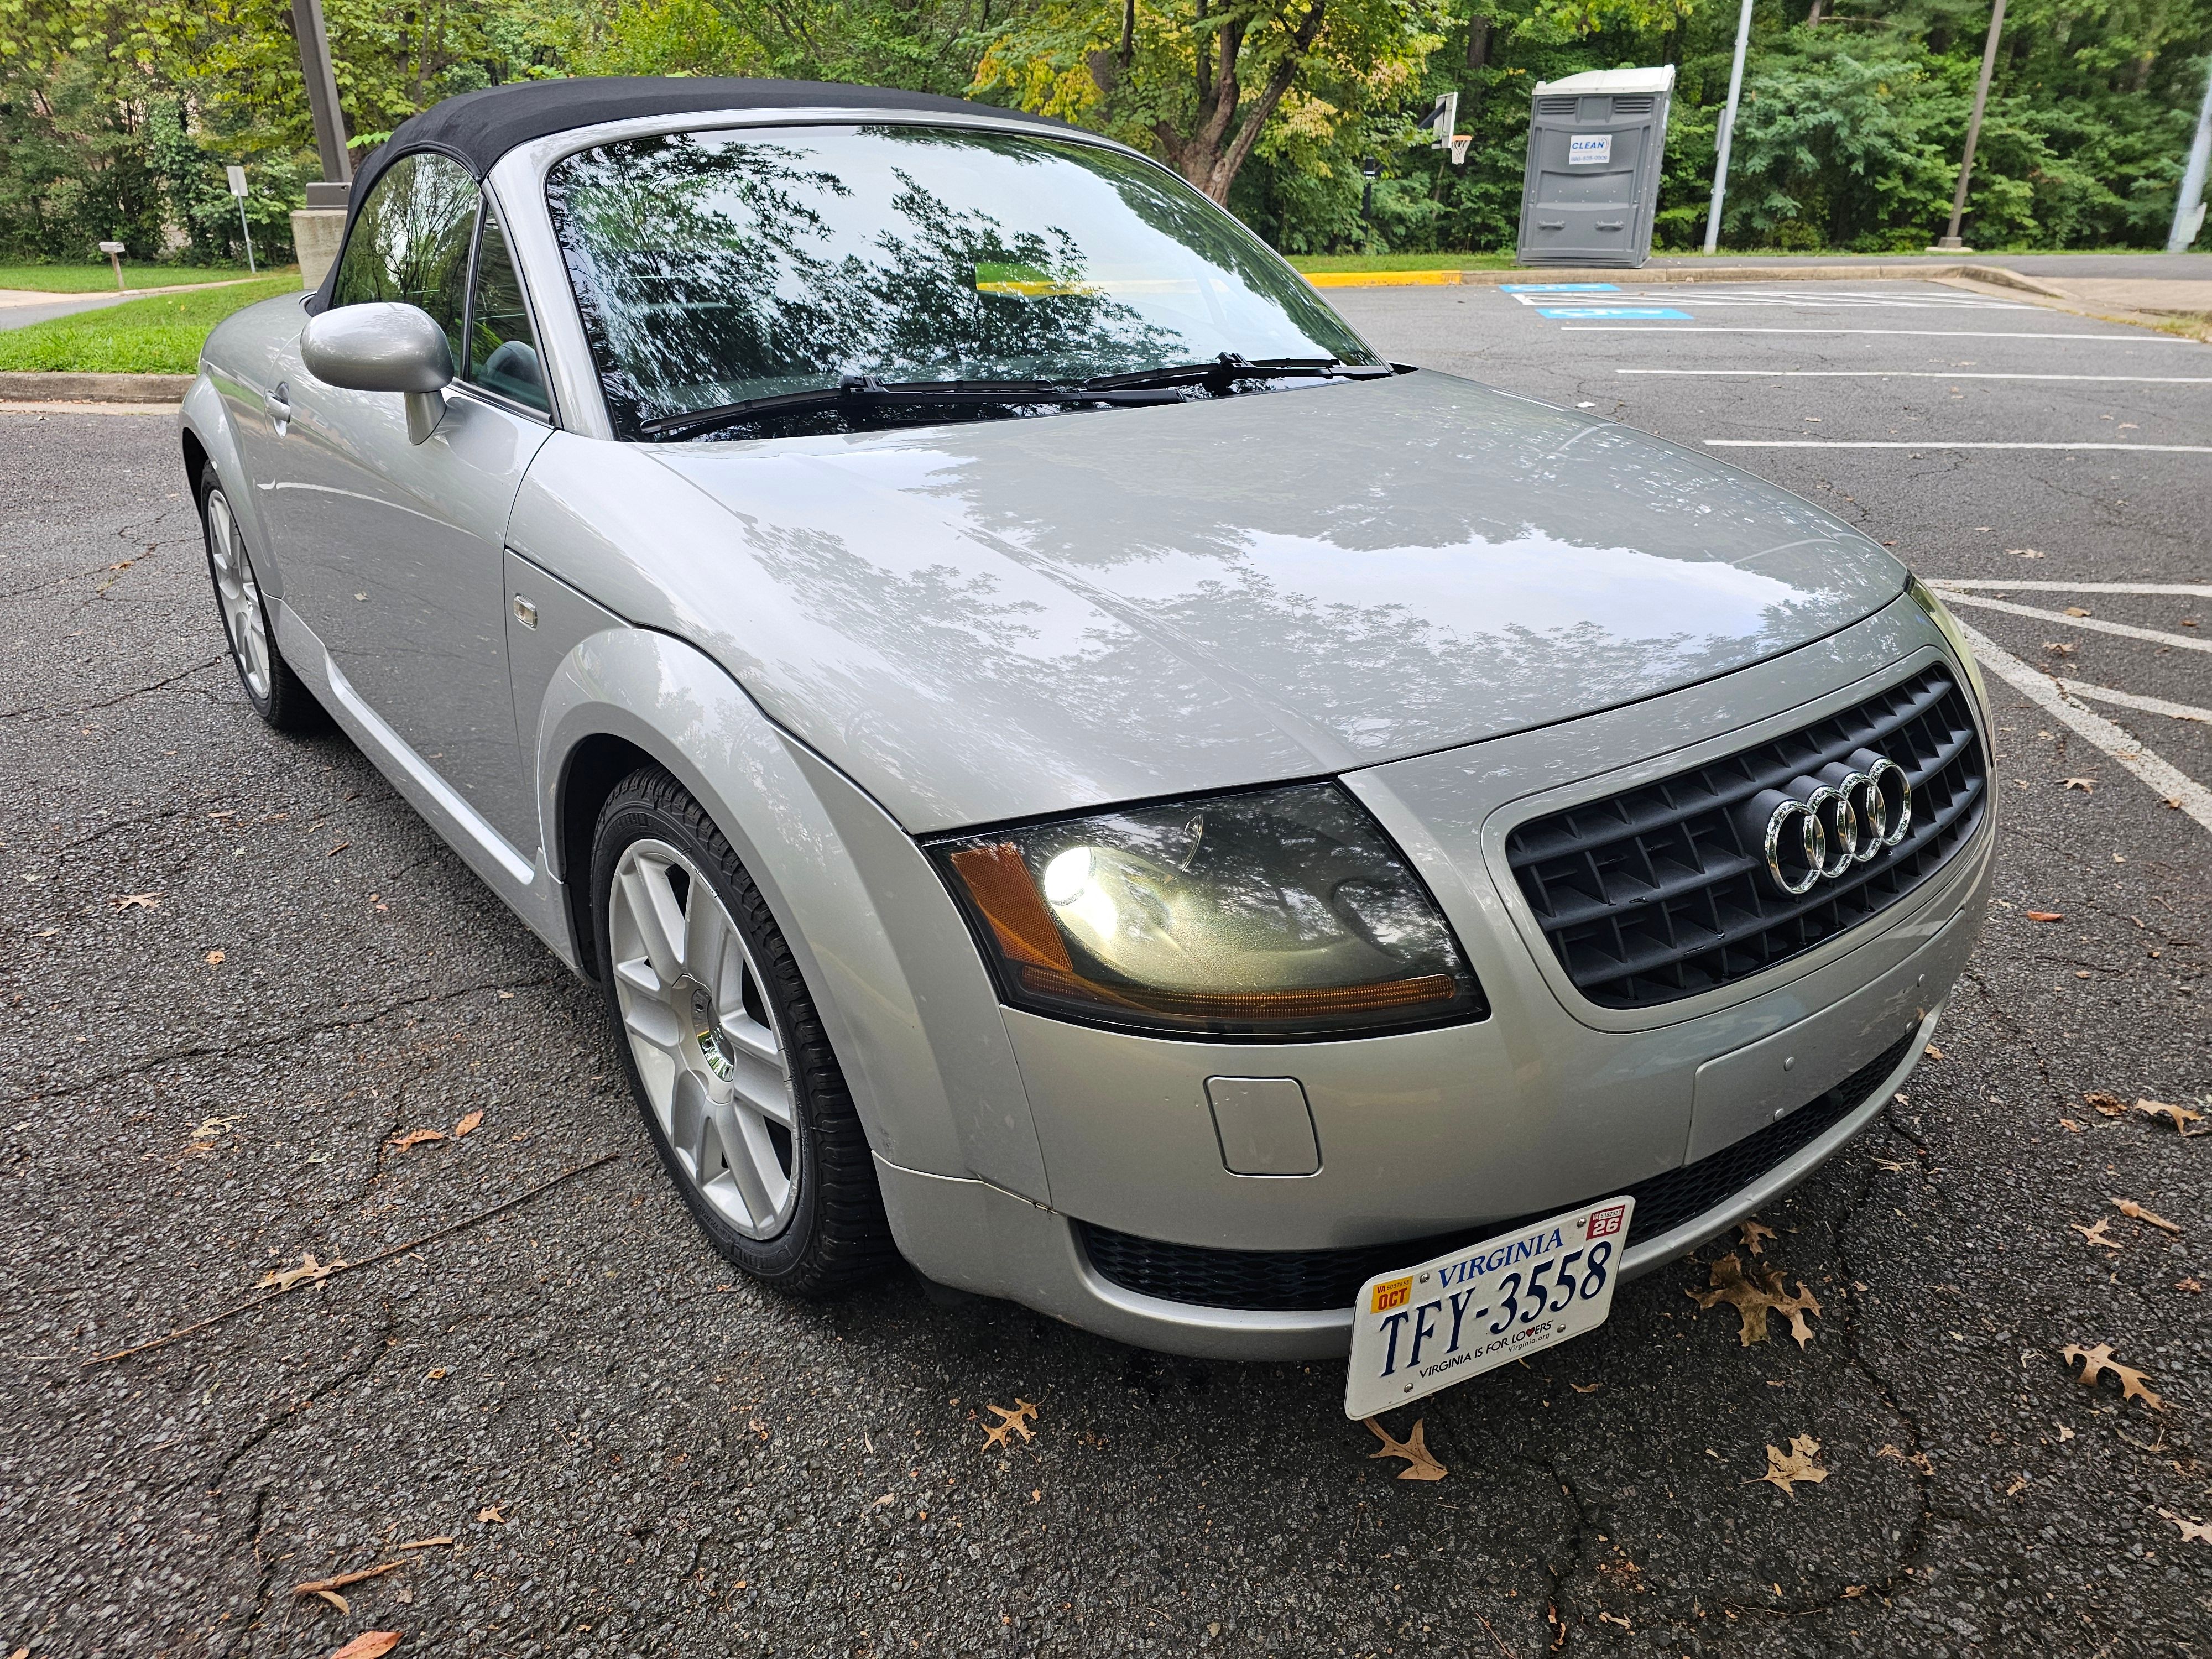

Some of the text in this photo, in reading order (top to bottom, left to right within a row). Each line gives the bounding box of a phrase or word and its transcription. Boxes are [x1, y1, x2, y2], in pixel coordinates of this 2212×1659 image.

[1593, 1217, 1620, 1236] 26
[1439, 1227, 1564, 1289] VIRGINIA
[1378, 1287, 1407, 1310] OCT
[1379, 1241, 1612, 1378] TFY-3558
[1419, 1352, 1471, 1378] VIRGINIA
[1474, 1347, 1483, 1359] IS
[1485, 1338, 1509, 1354] FOR
[1508, 1333, 1550, 1353] Virginia.org
